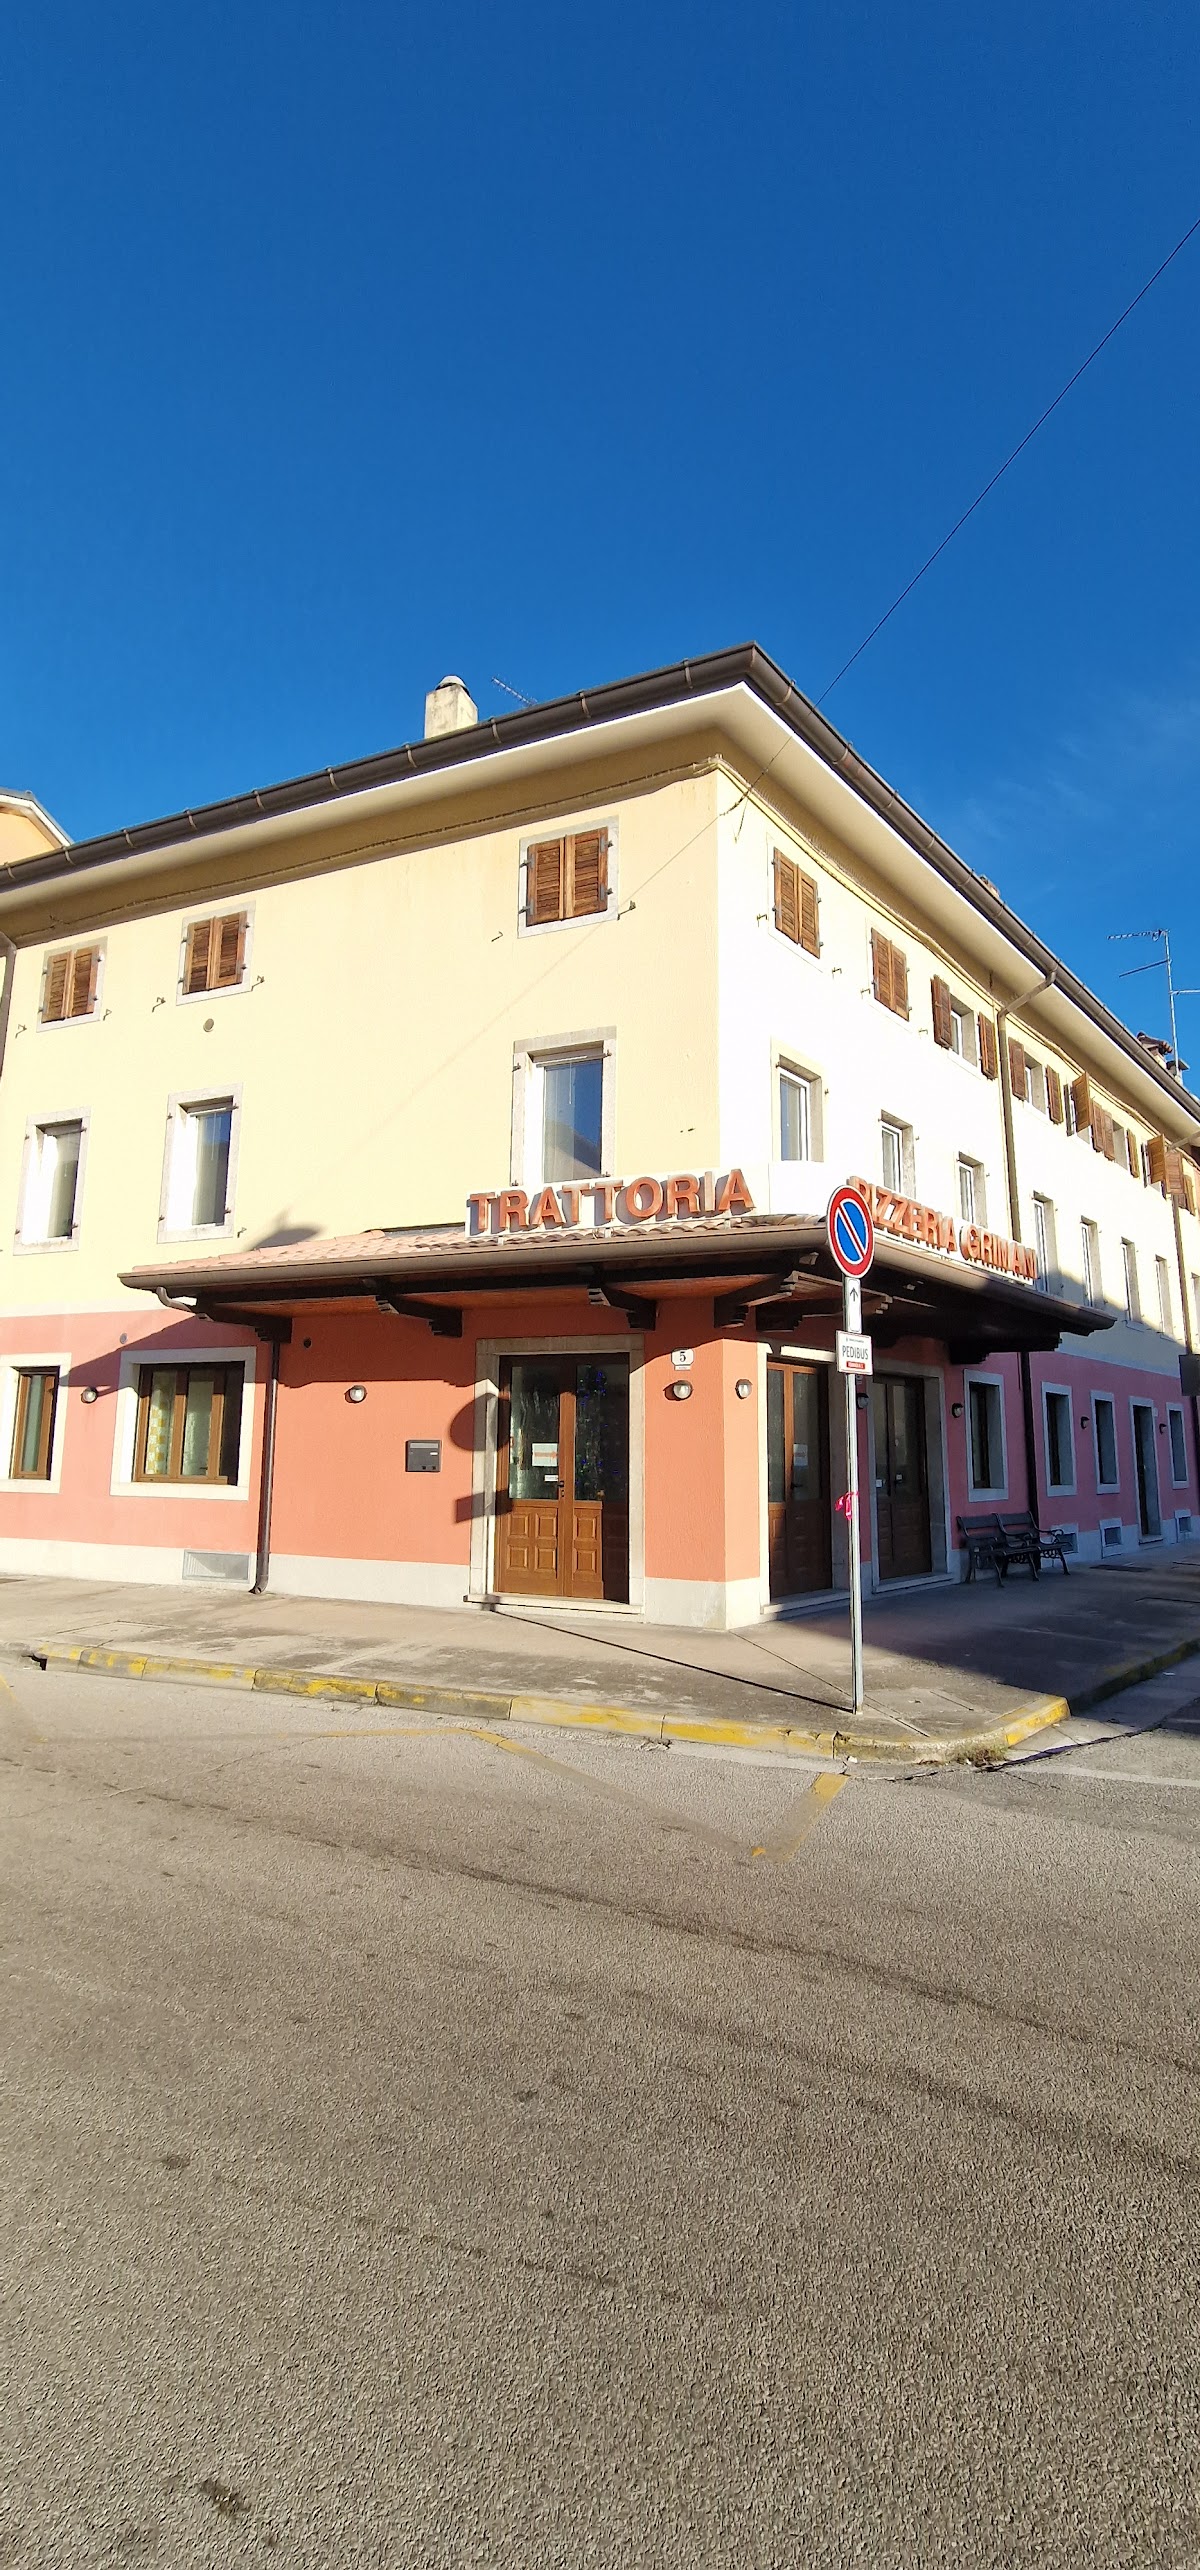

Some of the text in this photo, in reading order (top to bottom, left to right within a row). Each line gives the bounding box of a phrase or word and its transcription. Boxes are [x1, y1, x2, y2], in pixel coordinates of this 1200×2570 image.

[469, 1168, 755, 1231] TRATTORIA
[679, 1350, 686, 1362] 5
[842, 1345, 869, 1360] PEDIBUS
